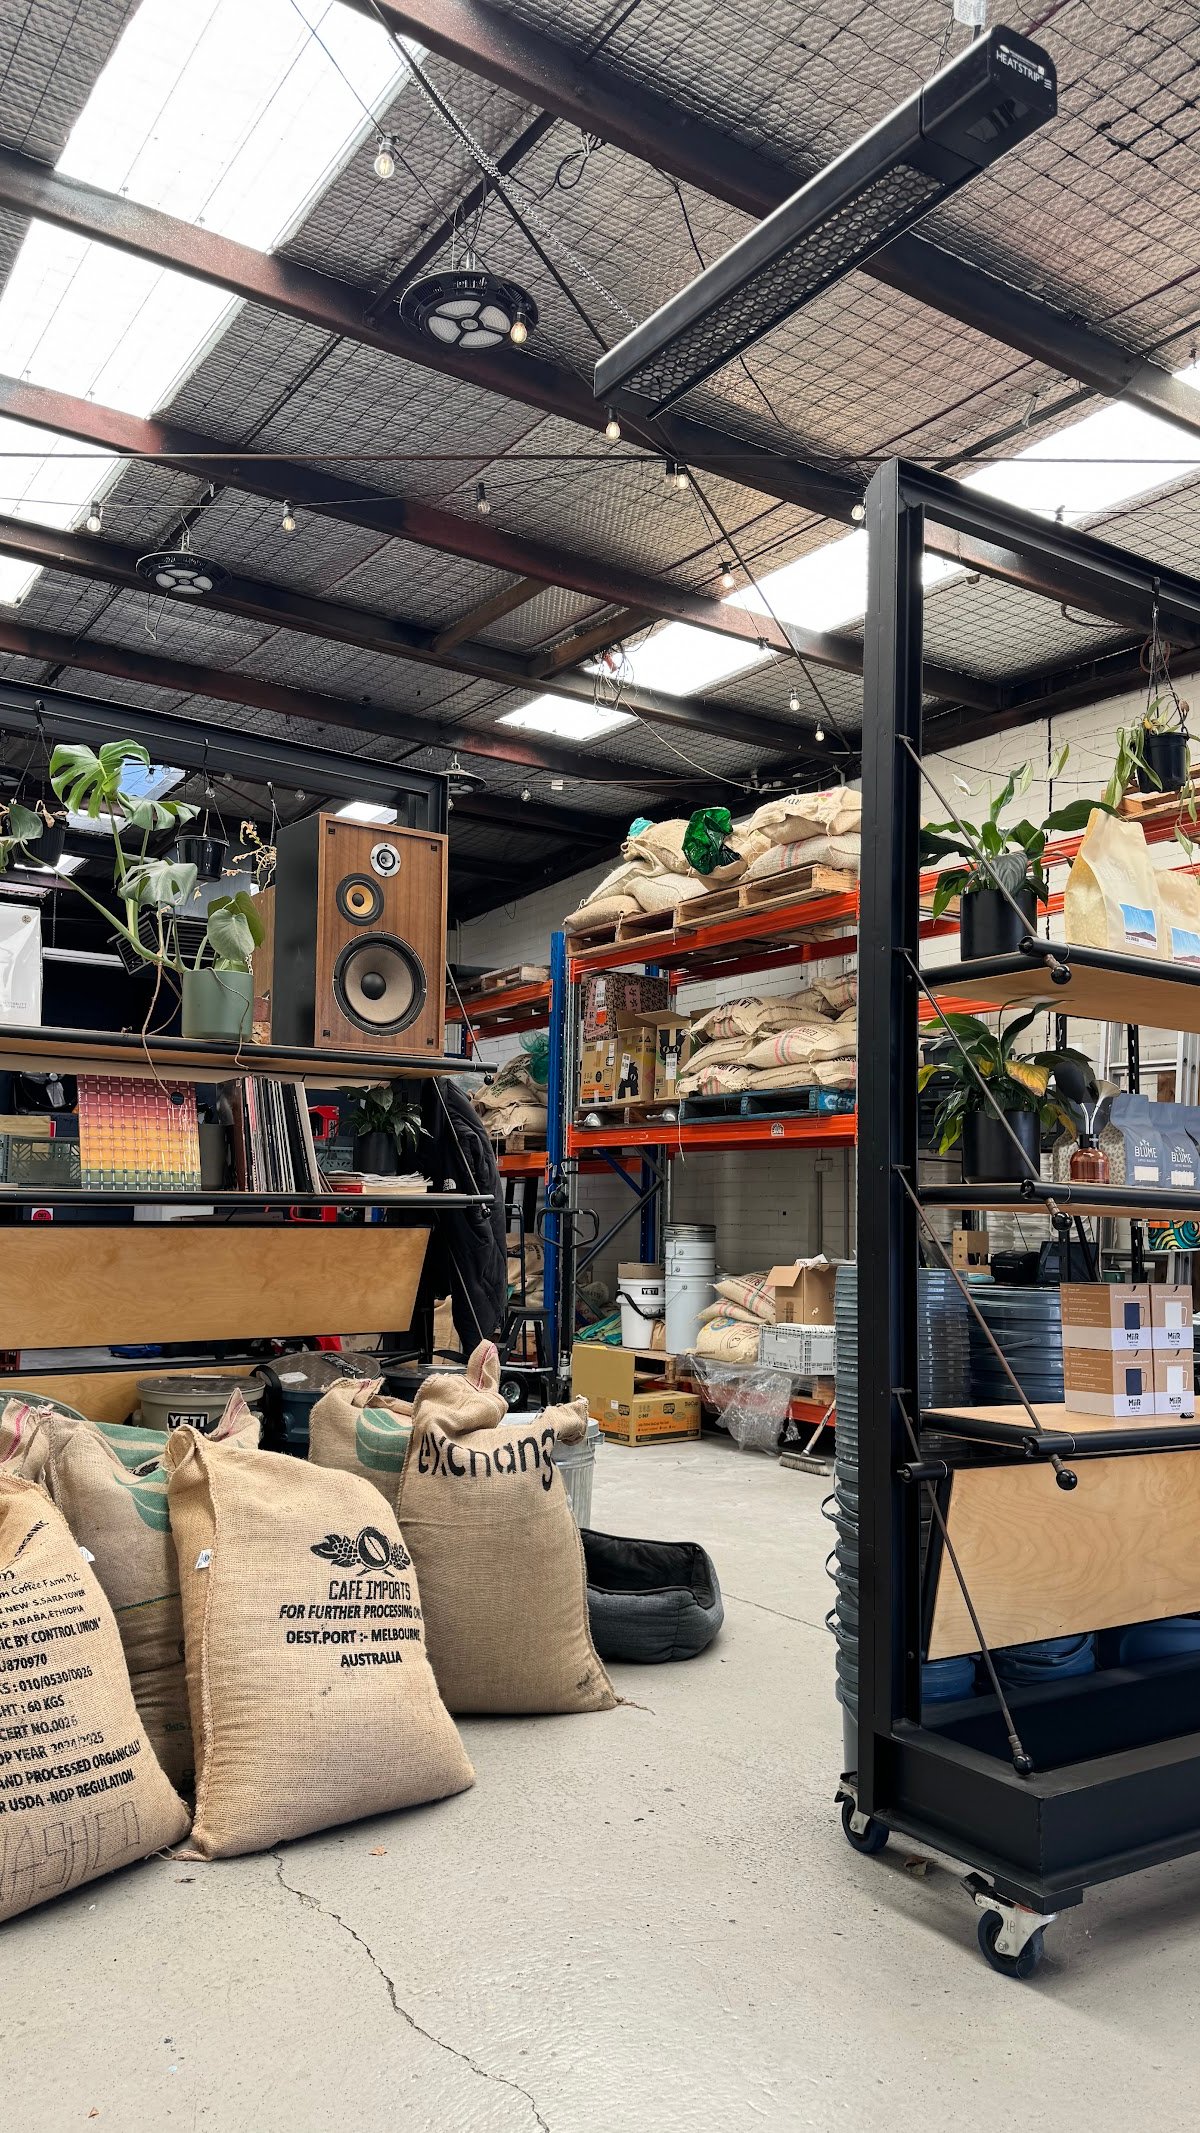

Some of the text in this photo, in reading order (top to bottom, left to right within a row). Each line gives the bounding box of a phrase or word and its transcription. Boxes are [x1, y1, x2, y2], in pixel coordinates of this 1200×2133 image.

[996, 50, 1041, 82] HEATSTRIP
[170, 1415, 205, 1428] YETI
[14, 1520, 50, 1558] ORGANIC
[11, 1582, 41, 1596] Coffee
[43, 1577, 65, 1588] Farm
[329, 1580, 411, 1601] CAFE IMPORTS
[5, 1602, 29, 1614] NEW
[64, 1589, 86, 1600] TOWER
[279, 1604, 305, 1619] FOR
[308, 1605, 361, 1620] FURTHER
[363, 1605, 413, 1619] PROCESSING
[14, 1633, 29, 1648] BY
[31, 1624, 76, 1644] CONTROL
[340, 1651, 403, 1668] AUSTRALIA
[0, 1703, 18, 1718] HT
[27, 1700, 42, 1713] 60
[43, 1694, 65, 1710] KGS
[13, 1745, 48, 1761] YEAR
[25, 1758, 91, 1785] PROCESSED
[92, 1738, 142, 1769] ORGANICALLY
[9, 1794, 45, 1812] USDA
[0, 1800, 140, 1904] ASHED
